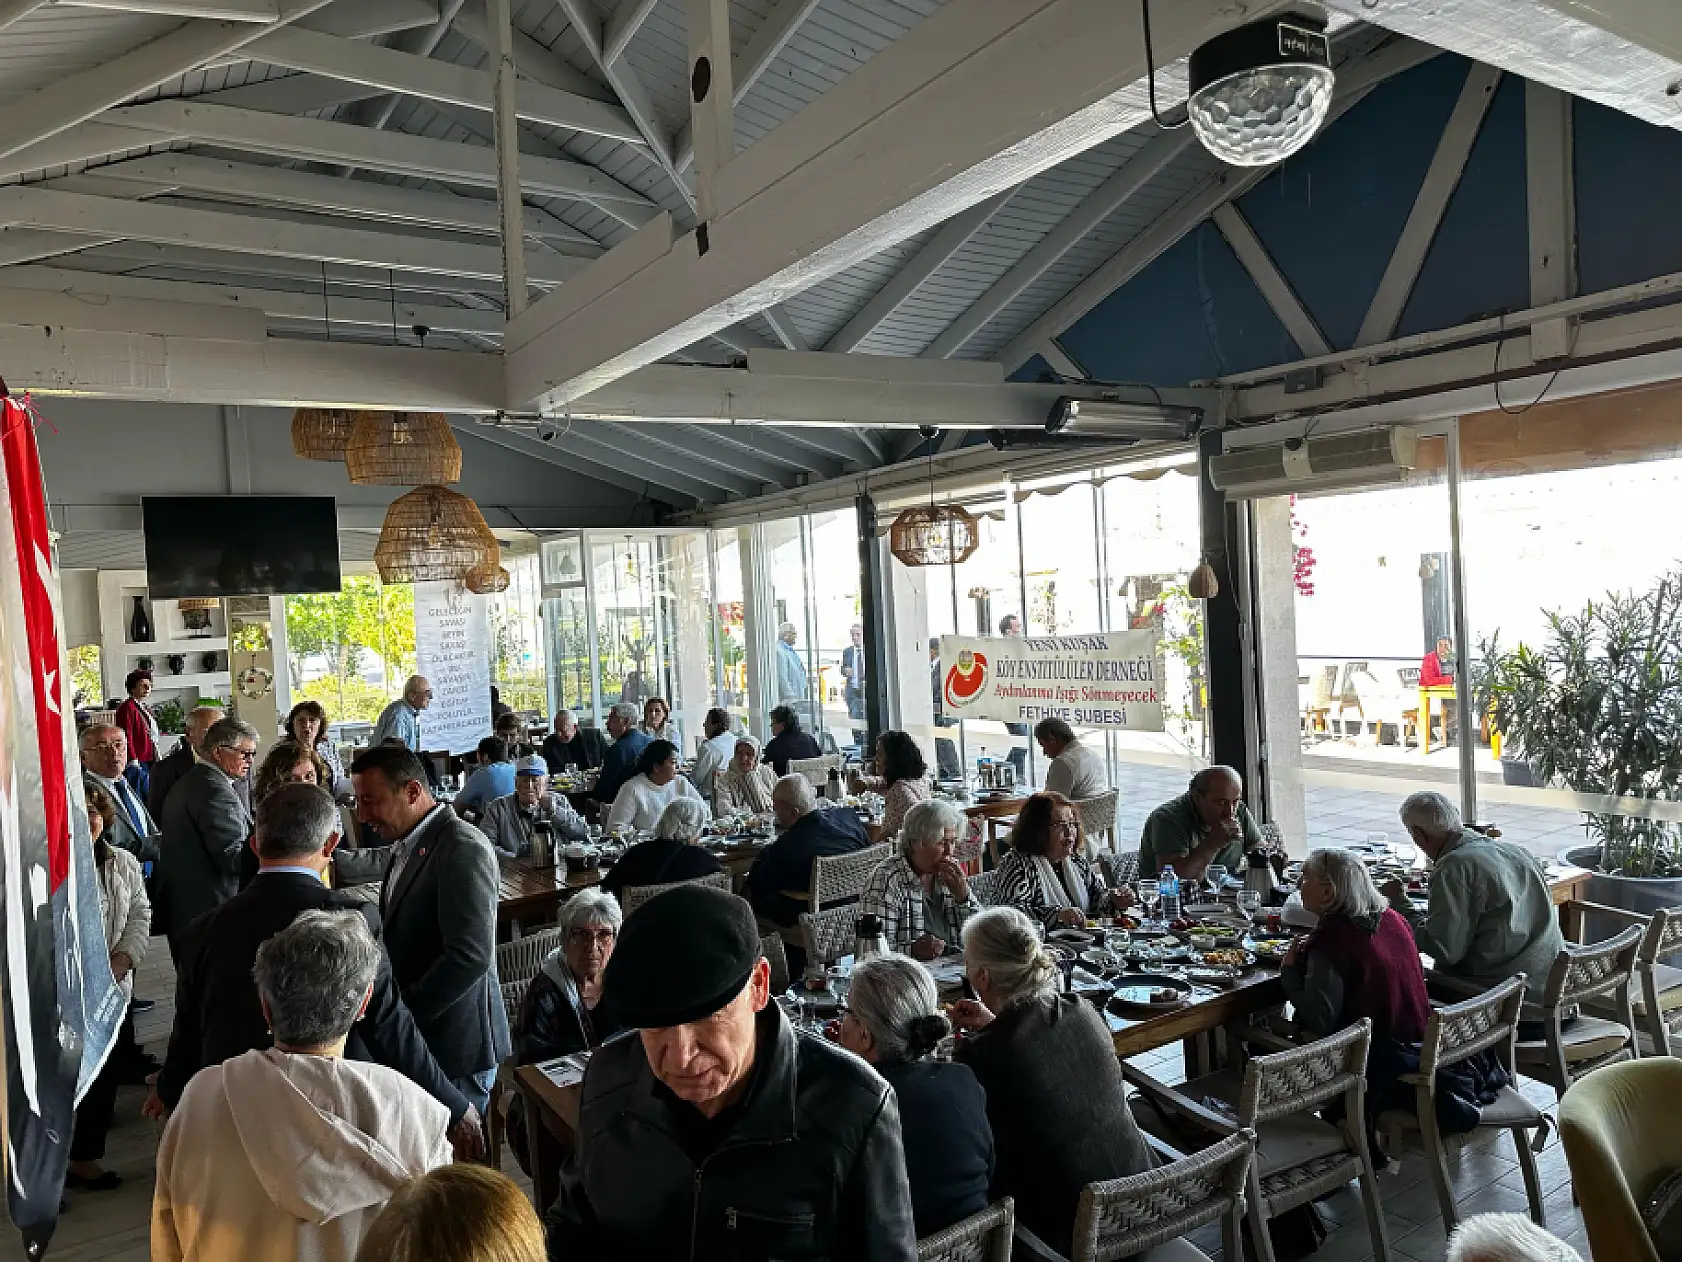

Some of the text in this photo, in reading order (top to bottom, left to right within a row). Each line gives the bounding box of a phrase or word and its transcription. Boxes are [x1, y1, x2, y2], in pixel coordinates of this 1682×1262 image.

[996, 654, 1016, 678] KÖY
[1096, 654, 1154, 682] DERNEĞİ
[1081, 685, 1158, 705] Sönmeyecek
[1019, 704, 1127, 726] FETHİYE ŞUBESİ
